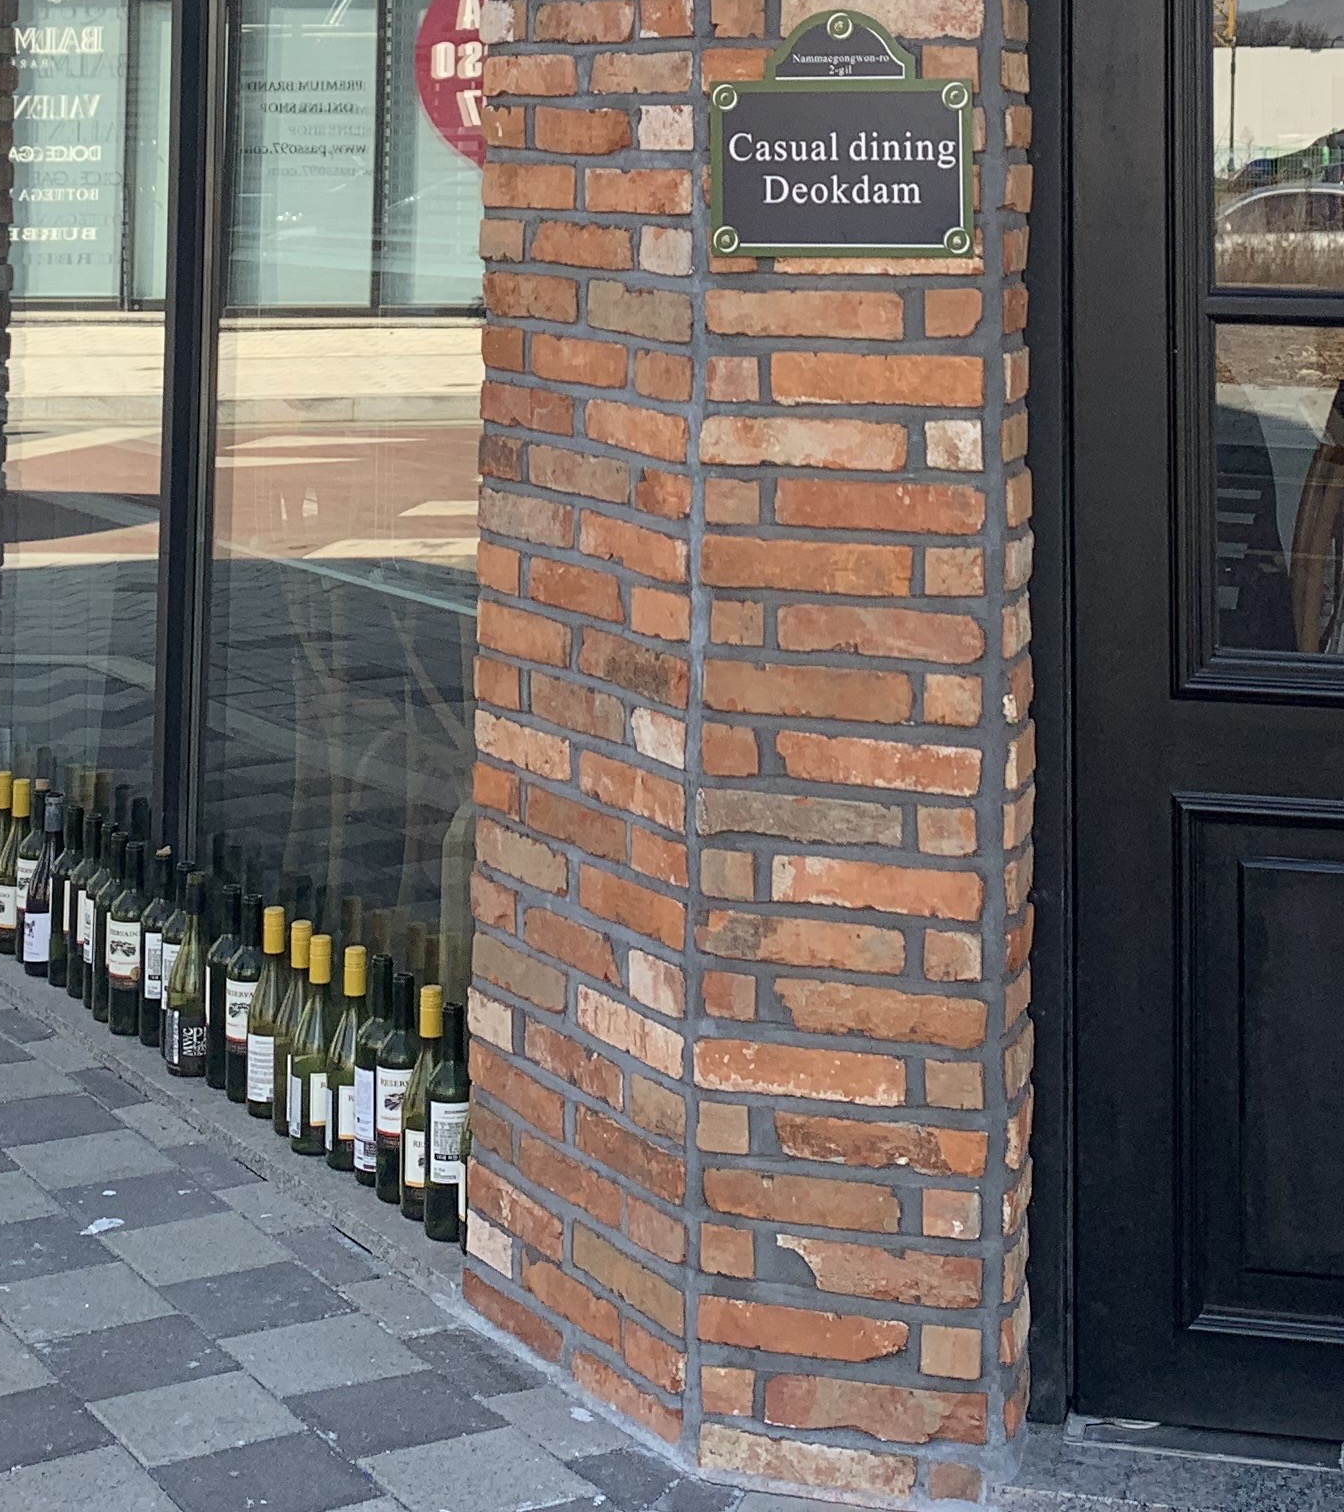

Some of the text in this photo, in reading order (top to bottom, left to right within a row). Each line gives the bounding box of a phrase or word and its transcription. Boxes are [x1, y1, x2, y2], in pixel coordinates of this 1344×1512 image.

[828, 64, 853, 76] 2-gil
[728, 132, 957, 169] Casual dining
[763, 175, 922, 204] Deokdam
